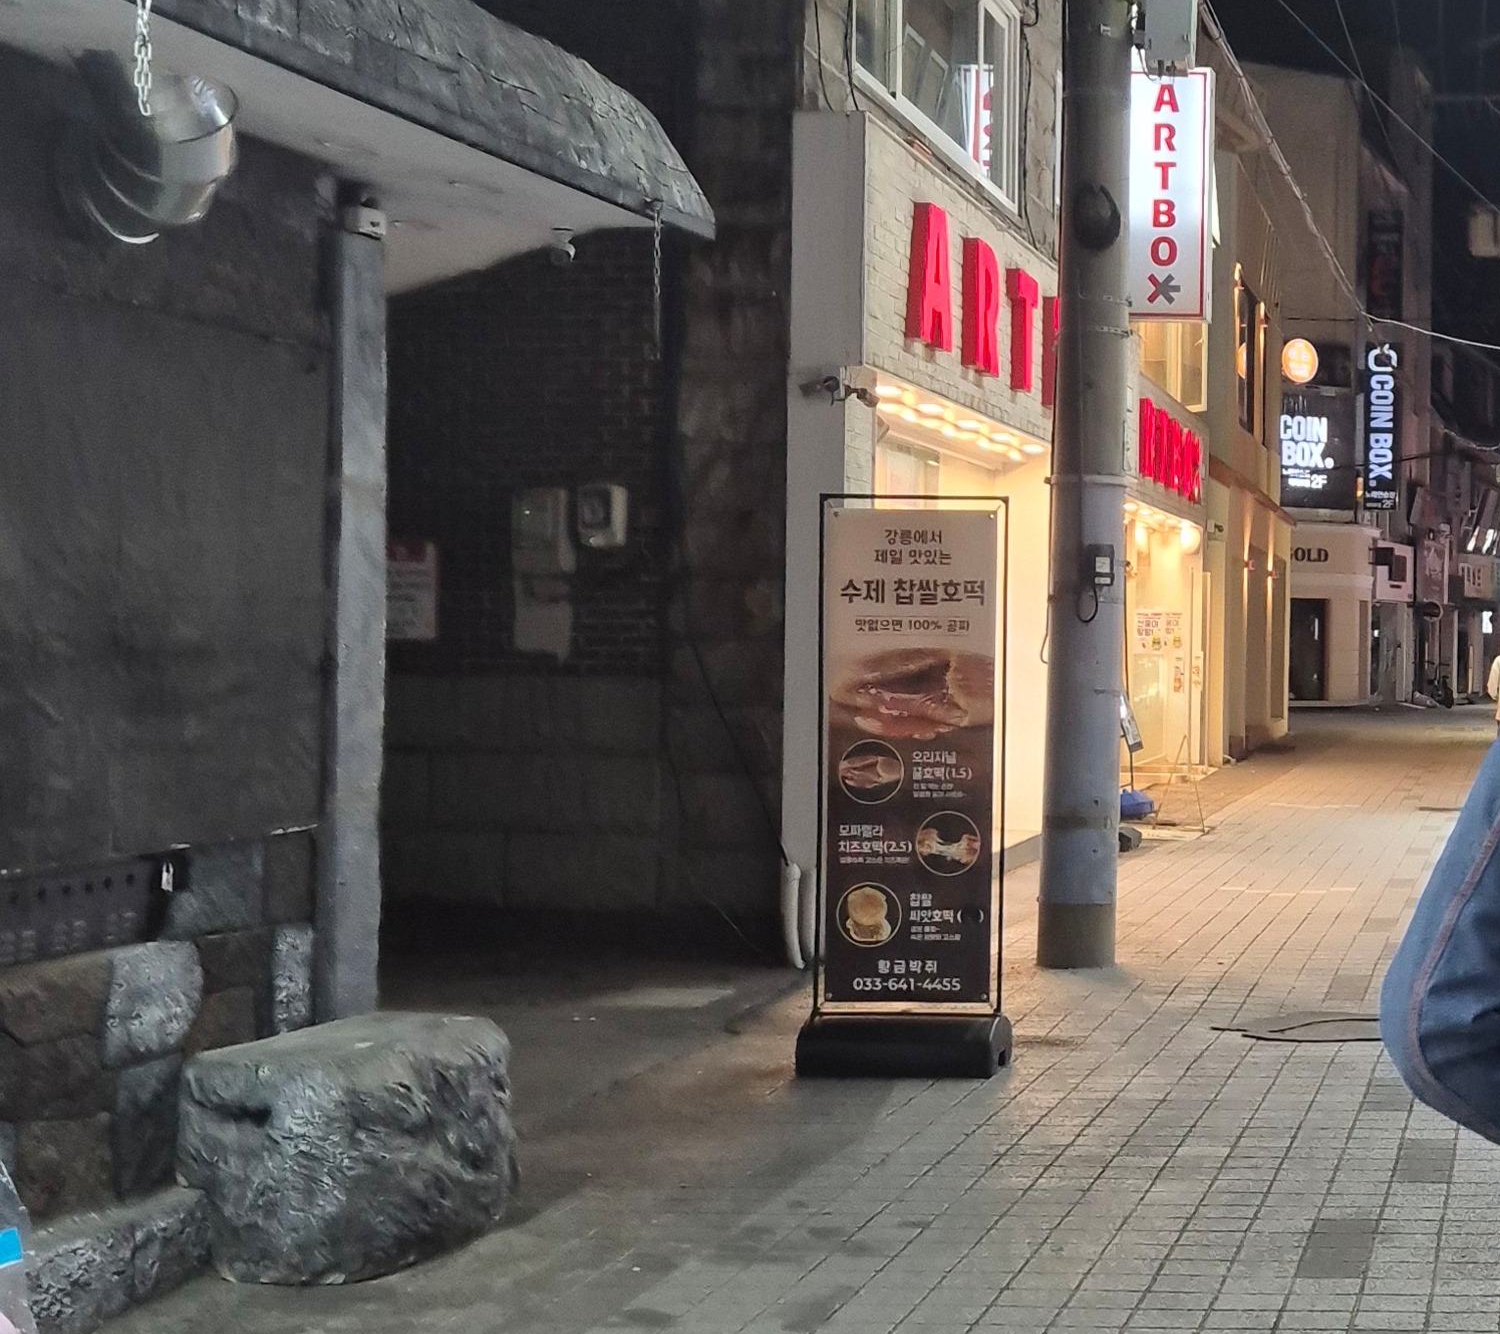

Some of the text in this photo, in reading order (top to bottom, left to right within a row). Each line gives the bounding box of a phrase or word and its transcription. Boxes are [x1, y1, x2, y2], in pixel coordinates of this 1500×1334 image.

[904, 202, 1058, 408] ART
[1370, 374, 1394, 427] COIN
[1280, 415, 1328, 442] COIN
[874, 549, 952, 565] 제일 맛있는
[840, 578, 985, 606] 수제 찹쌀호떡
[908, 619, 943, 631] 100%
[852, 978, 961, 991] 033-641-4455
